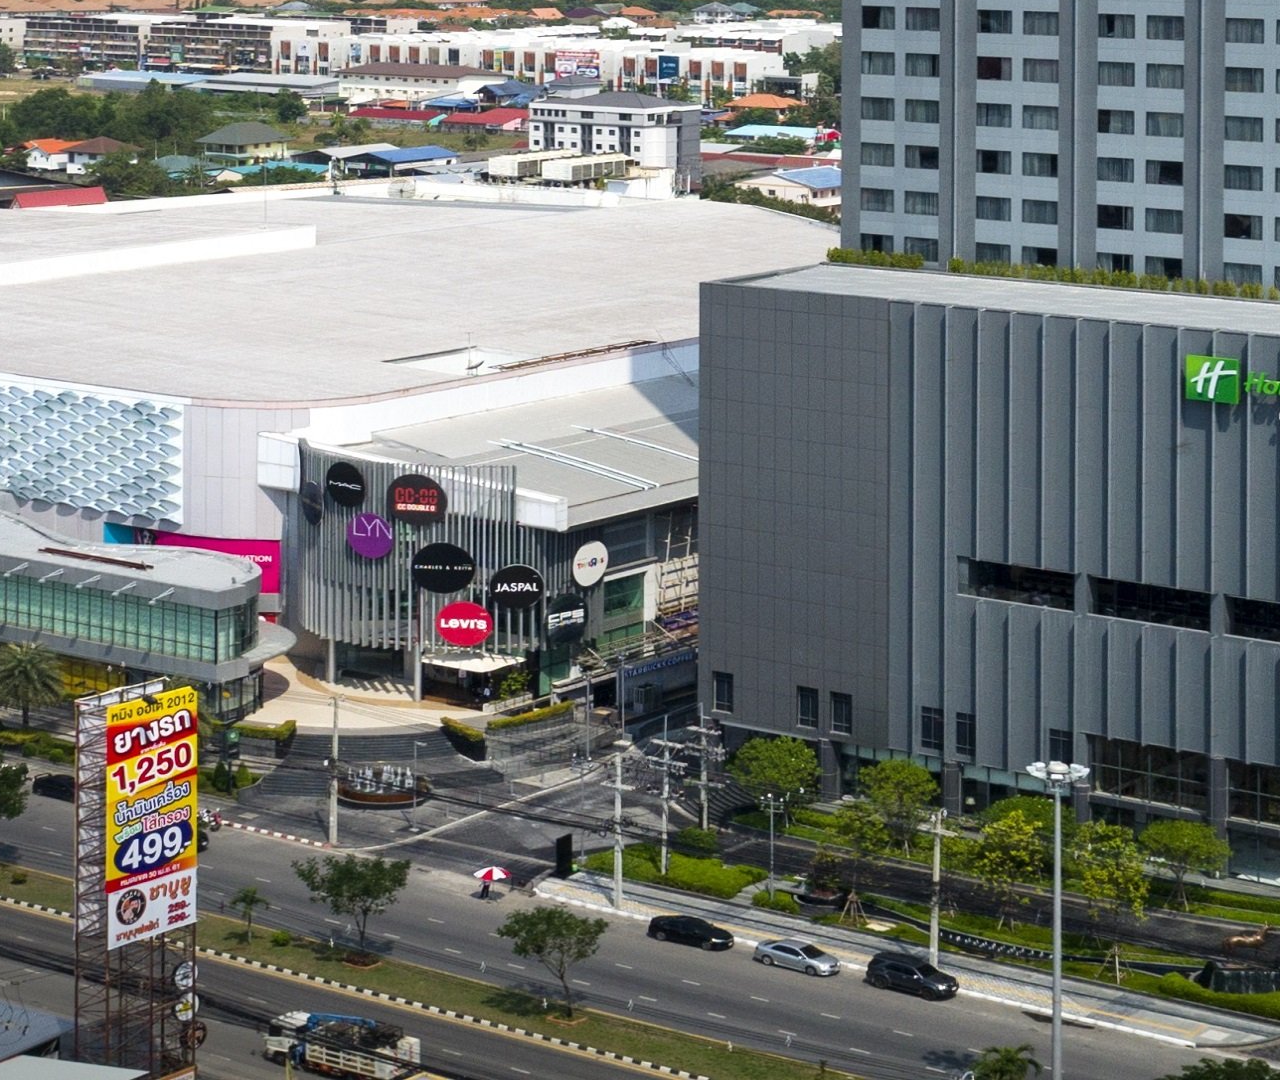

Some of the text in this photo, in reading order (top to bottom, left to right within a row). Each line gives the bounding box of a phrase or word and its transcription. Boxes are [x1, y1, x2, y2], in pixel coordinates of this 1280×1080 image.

[328, 480, 362, 491] MAC
[407, 503, 429, 511] DOUBLE
[352, 517, 392, 539] LYN
[494, 581, 539, 593] JASPAL
[167, 692, 195, 709] 2012
[114, 709, 191, 754] ยางรถ
[112, 742, 192, 793] 1,250
[115, 781, 189, 824] น้ำมันเครื่อง
[121, 826, 192, 869] 499.-
